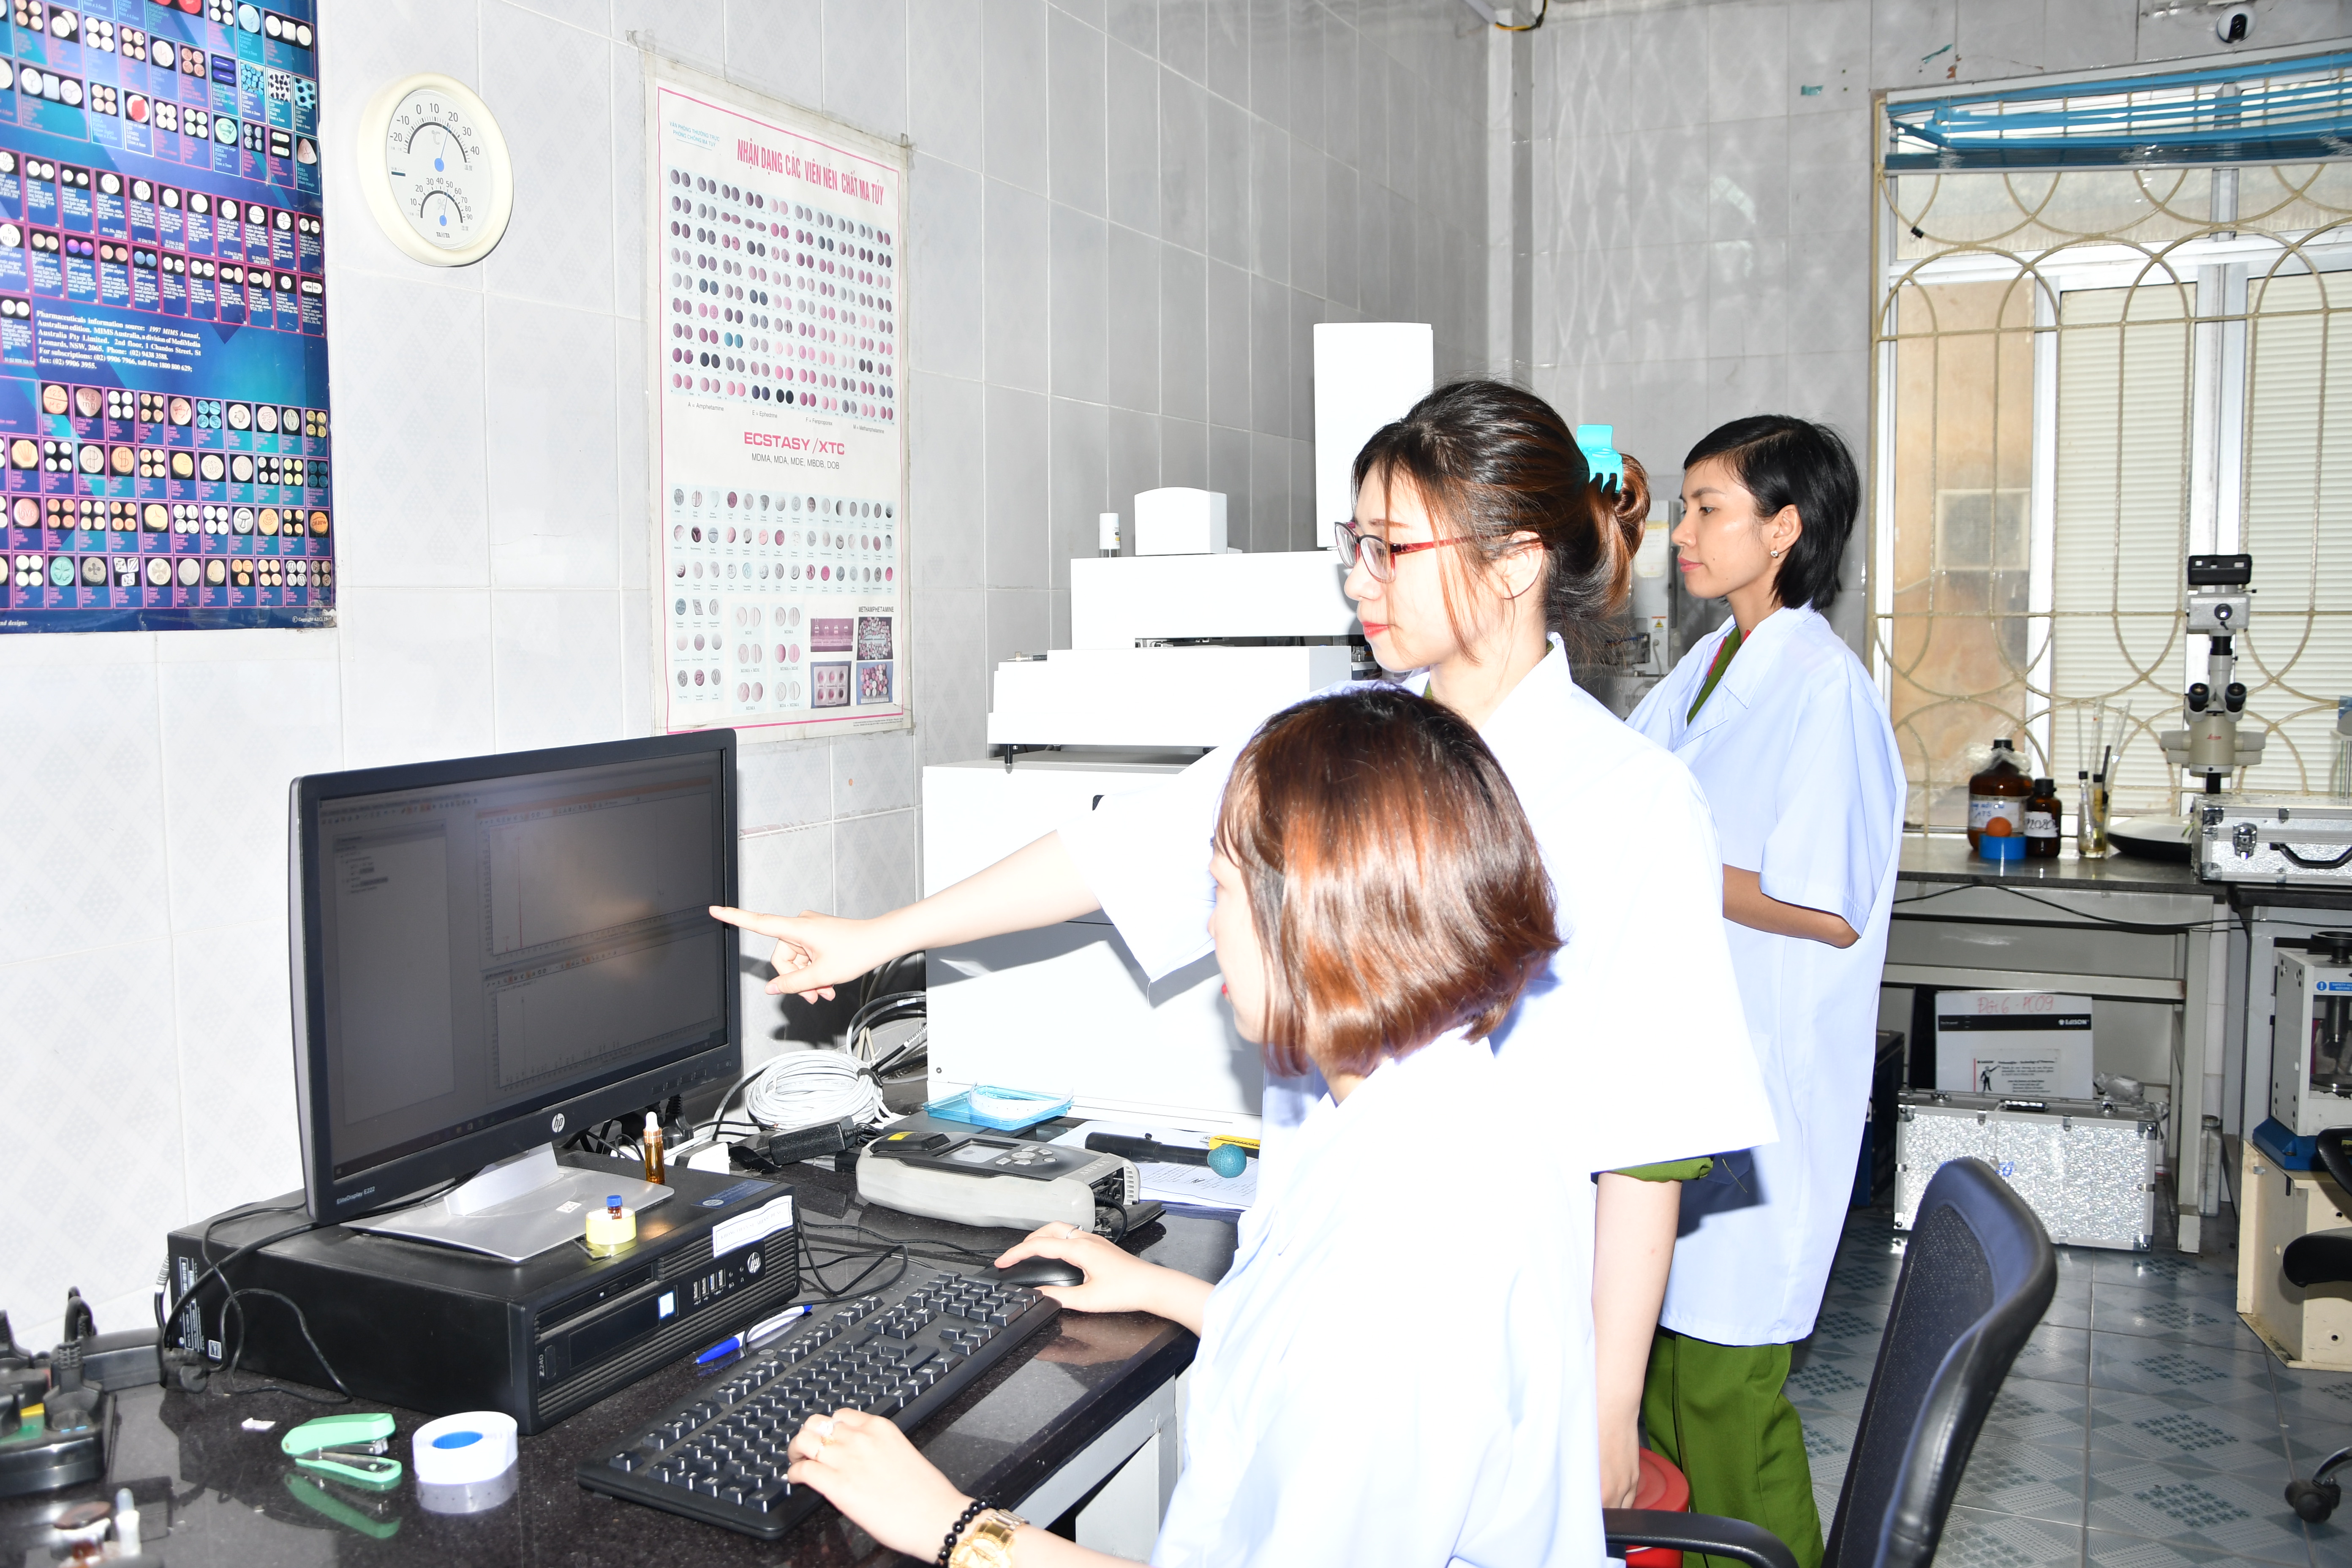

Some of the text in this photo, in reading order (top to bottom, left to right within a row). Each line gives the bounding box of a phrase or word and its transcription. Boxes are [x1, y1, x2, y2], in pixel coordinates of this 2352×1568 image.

[416, 104, 422, 115] 0
[430, 103, 439, 114] 10
[396, 115, 410, 125] -10
[448, 112, 459, 122] 20
[462, 127, 471, 136] 30
[389, 132, 403, 142] -20
[470, 146, 480, 155] 40
[737, 137, 884, 206] NHẬN DẠNG CÁC VIÊN NÉN CHẤT MA TÚY
[426, 177, 434, 186] 30
[415, 185, 423, 193] 20
[410, 198, 417, 206] 10
[36, 310, 86, 324] Pharmaceuticals
[88, 318, 123, 328] information
[162, 328, 178, 336] MIMS
[180, 330, 200, 340] Annual,
[37, 320, 68, 331] Australian
[69, 324, 92, 334] edition.
[94, 327, 113, 336] MIMS
[114, 329, 142, 340] Australia,
[146, 334, 166, 344] division
[172, 338, 201, 348] MediMedia
[38, 329, 67, 339] Australia
[69, 333, 79, 341] Pty
[83, 334, 110, 344] Limited.
[128, 340, 144, 349] floor,
[151, 343, 173, 352] Chandos
[175, 346, 193, 356] Street,
[39, 338, 68, 349] Leonards,
[69, 341, 86, 351] NSW,
[88, 344, 104, 353] 2065.
[107, 346, 127, 355] Phone:
[129, 349, 141, 357] (02)
[51, 349, 93, 360] subscriptions:
[94, 353, 106, 361] (02)
[122, 357, 137, 365] 7966,
[148, 359, 158, 368] free
[181, 364, 193, 373] 629;
[65, 359, 79, 368] 9906
[81, 361, 97, 369] 3955.
[696, 403, 724, 411] Amphetamine
[812, 418, 833, 427] Fenproporex
[859, 425, 885, 434] Methamphetamine
[744, 431, 810, 451] ECSTASY
[751, 453, 840, 470] MDMA, MDA, MDE, MBDB, DOB
[1080, 1161, 1109, 1175] AHURA
[336, 1186, 375, 1204] EliteDisplay E222
